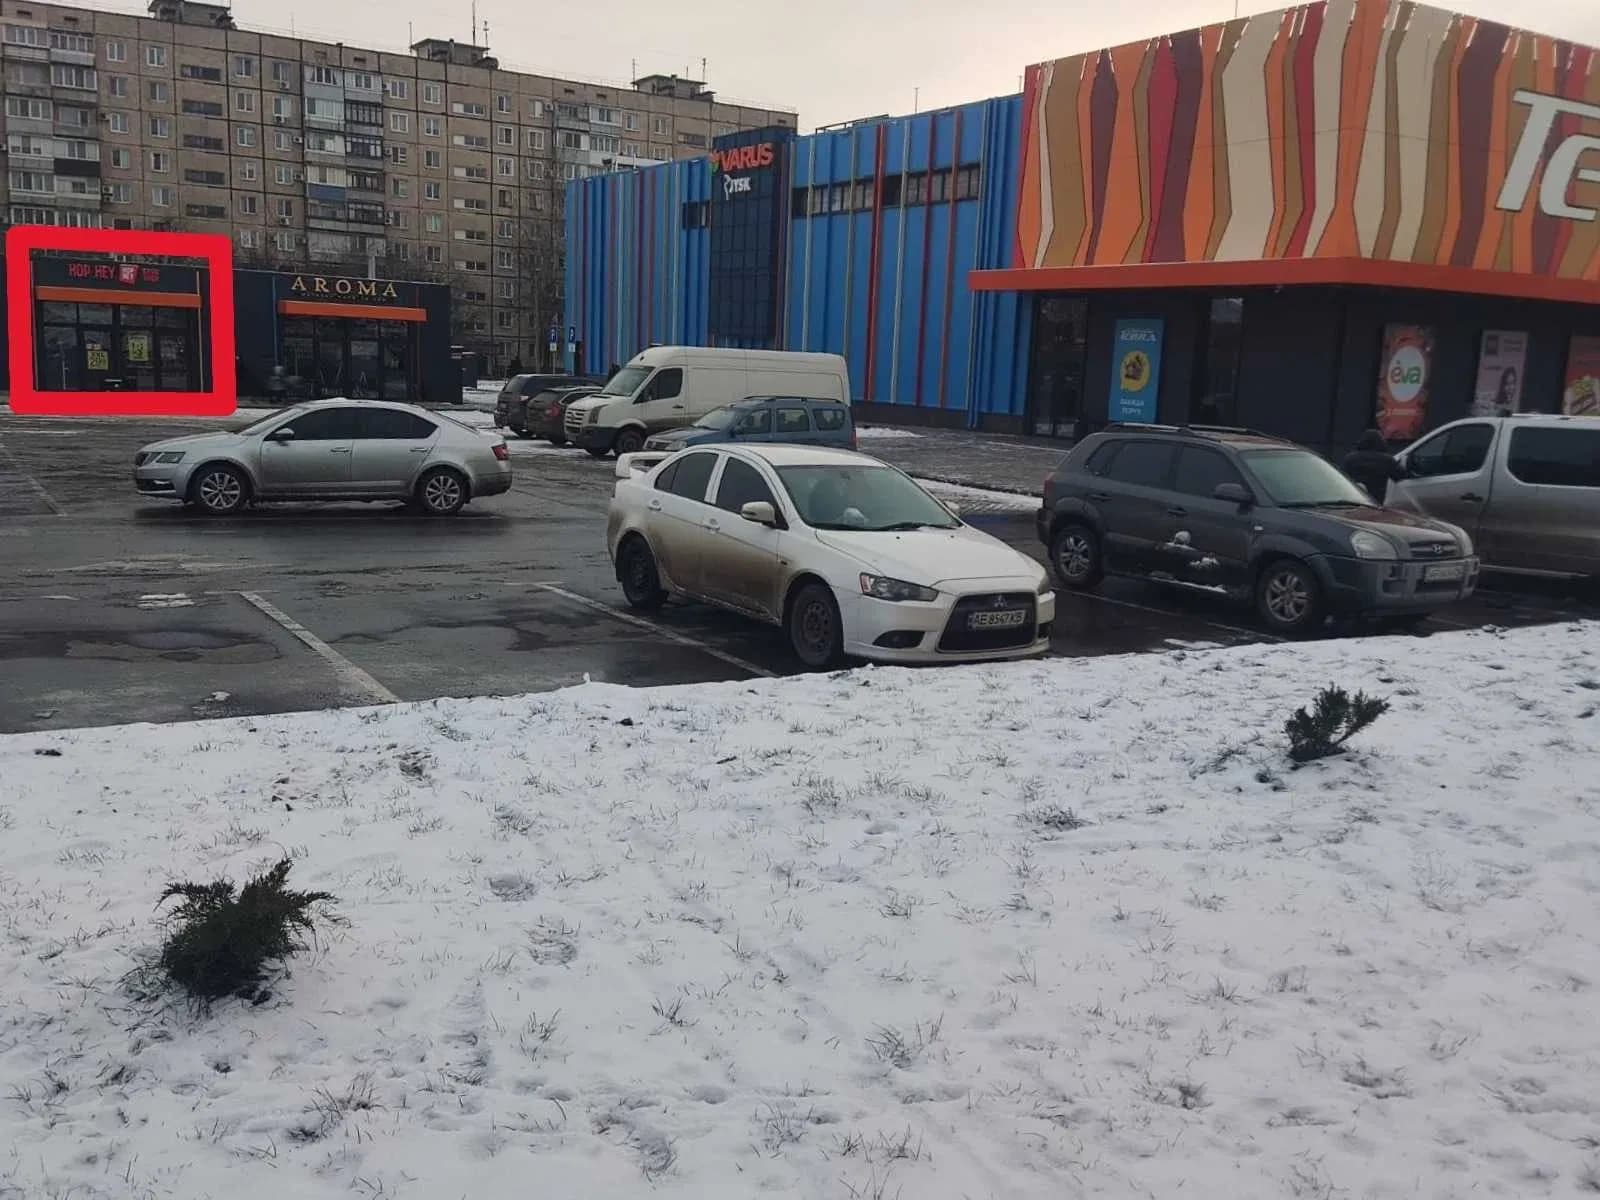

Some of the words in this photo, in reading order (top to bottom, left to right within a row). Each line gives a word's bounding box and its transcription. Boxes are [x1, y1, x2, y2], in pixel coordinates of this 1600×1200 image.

[720, 143, 774, 171] VARUS
[729, 177, 752, 194] JYSK
[68, 263, 91, 279] HOP
[95, 264, 115, 280] HEY
[290, 276, 398, 298] AROMA
